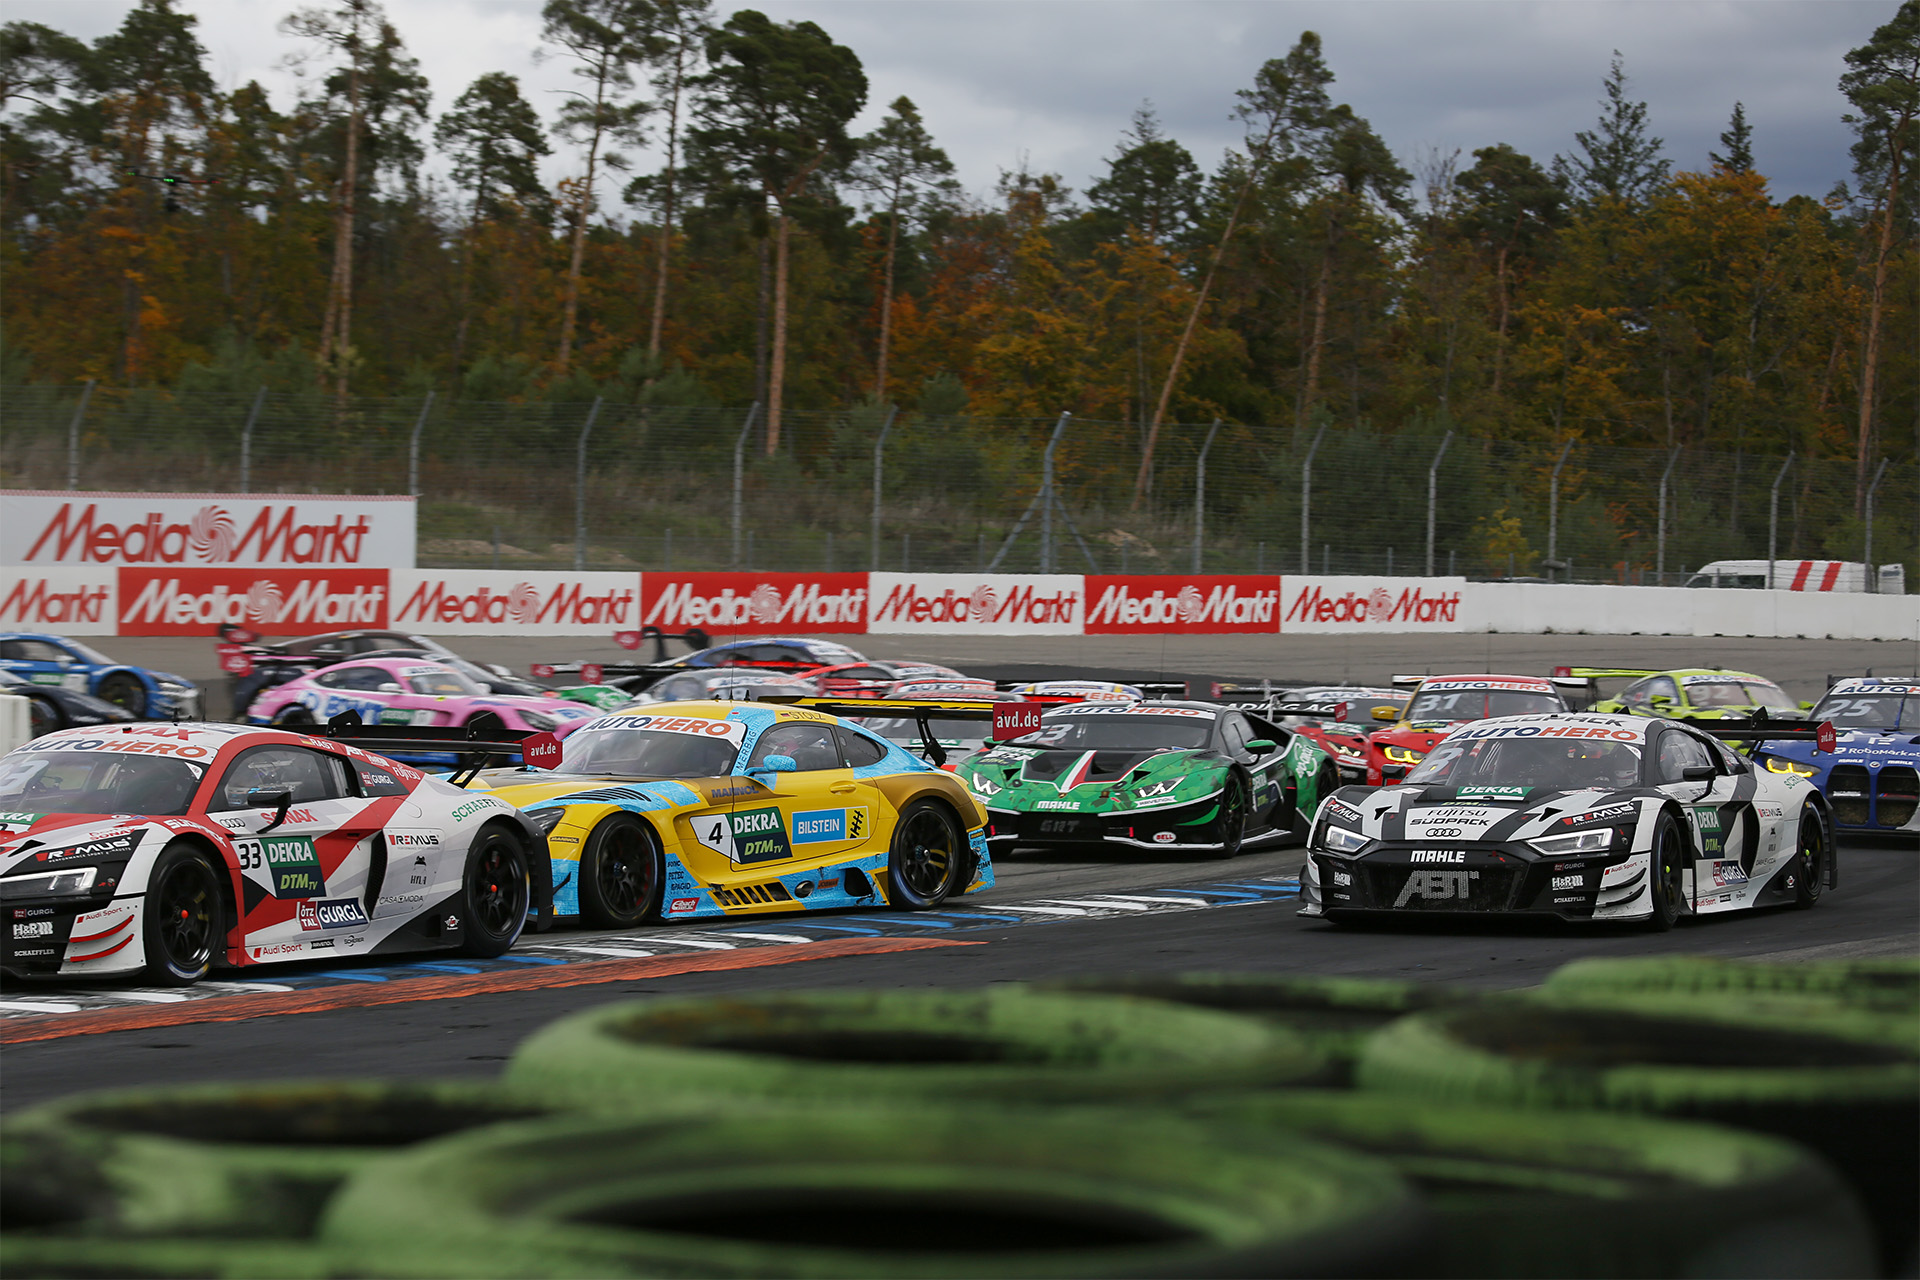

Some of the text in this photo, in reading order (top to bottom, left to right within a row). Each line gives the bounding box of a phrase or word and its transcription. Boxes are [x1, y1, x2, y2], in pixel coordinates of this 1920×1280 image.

[22, 503, 371, 563] Media Markt
[120, 578, 384, 623] Media Markt
[394, 580, 633, 624] Media Markt
[644, 583, 866, 625] Media Markt
[874, 584, 1076, 624] Media Markt
[1087, 585, 1277, 624] Media Markt
[1286, 586, 1460, 623] Media Markt
[1428, 682, 1549, 692] AUTOHERO
[1056, 707, 1200, 717] AUTOHERO
[1415, 694, 1462, 713] 31
[1816, 699, 1880, 719] 25
[586, 716, 732, 736] AUTOHERO
[996, 711, 1039, 728] avd.de
[1449, 726, 1638, 741] AUTOHERO
[1820, 732, 1834, 743] avd.de
[20, 739, 208, 758] AUTOHERO
[309, 738, 336, 751] RAST
[530, 743, 556, 757] avd.de
[735, 730, 757, 771] MERBAG
[711, 784, 760, 798] MANNOL
[1461, 786, 1523, 794] DEKRA
[1037, 801, 1081, 810] MAHLE
[1427, 807, 1488, 817] FUJITSU
[734, 812, 779, 834] DEKRA
[797, 818, 840, 835] BILSTEIN
[1040, 819, 1079, 833] GRT
[1697, 811, 1720, 828] DEKRA
[396, 835, 439, 845] REMUS
[708, 822, 723, 845] 4
[47, 838, 130, 859] REMUS
[238, 842, 262, 870] 33
[268, 841, 313, 863] DEKRA
[744, 839, 774, 856] DTM
[1410, 850, 1466, 863] MAHLE
[280, 874, 309, 890] DTM
[1393, 870, 1479, 908] ABT
[27, 908, 55, 916] GURGL
[86, 907, 122, 921] Audi Sport
[300, 905, 314, 918] ÖTZ
[319, 903, 365, 924] GURGL
[13, 923, 38, 936] H&R
[301, 918, 318, 928] TAL
[14, 948, 55, 957] SCHAEFFLER
[263, 943, 302, 956] Audi Sport
